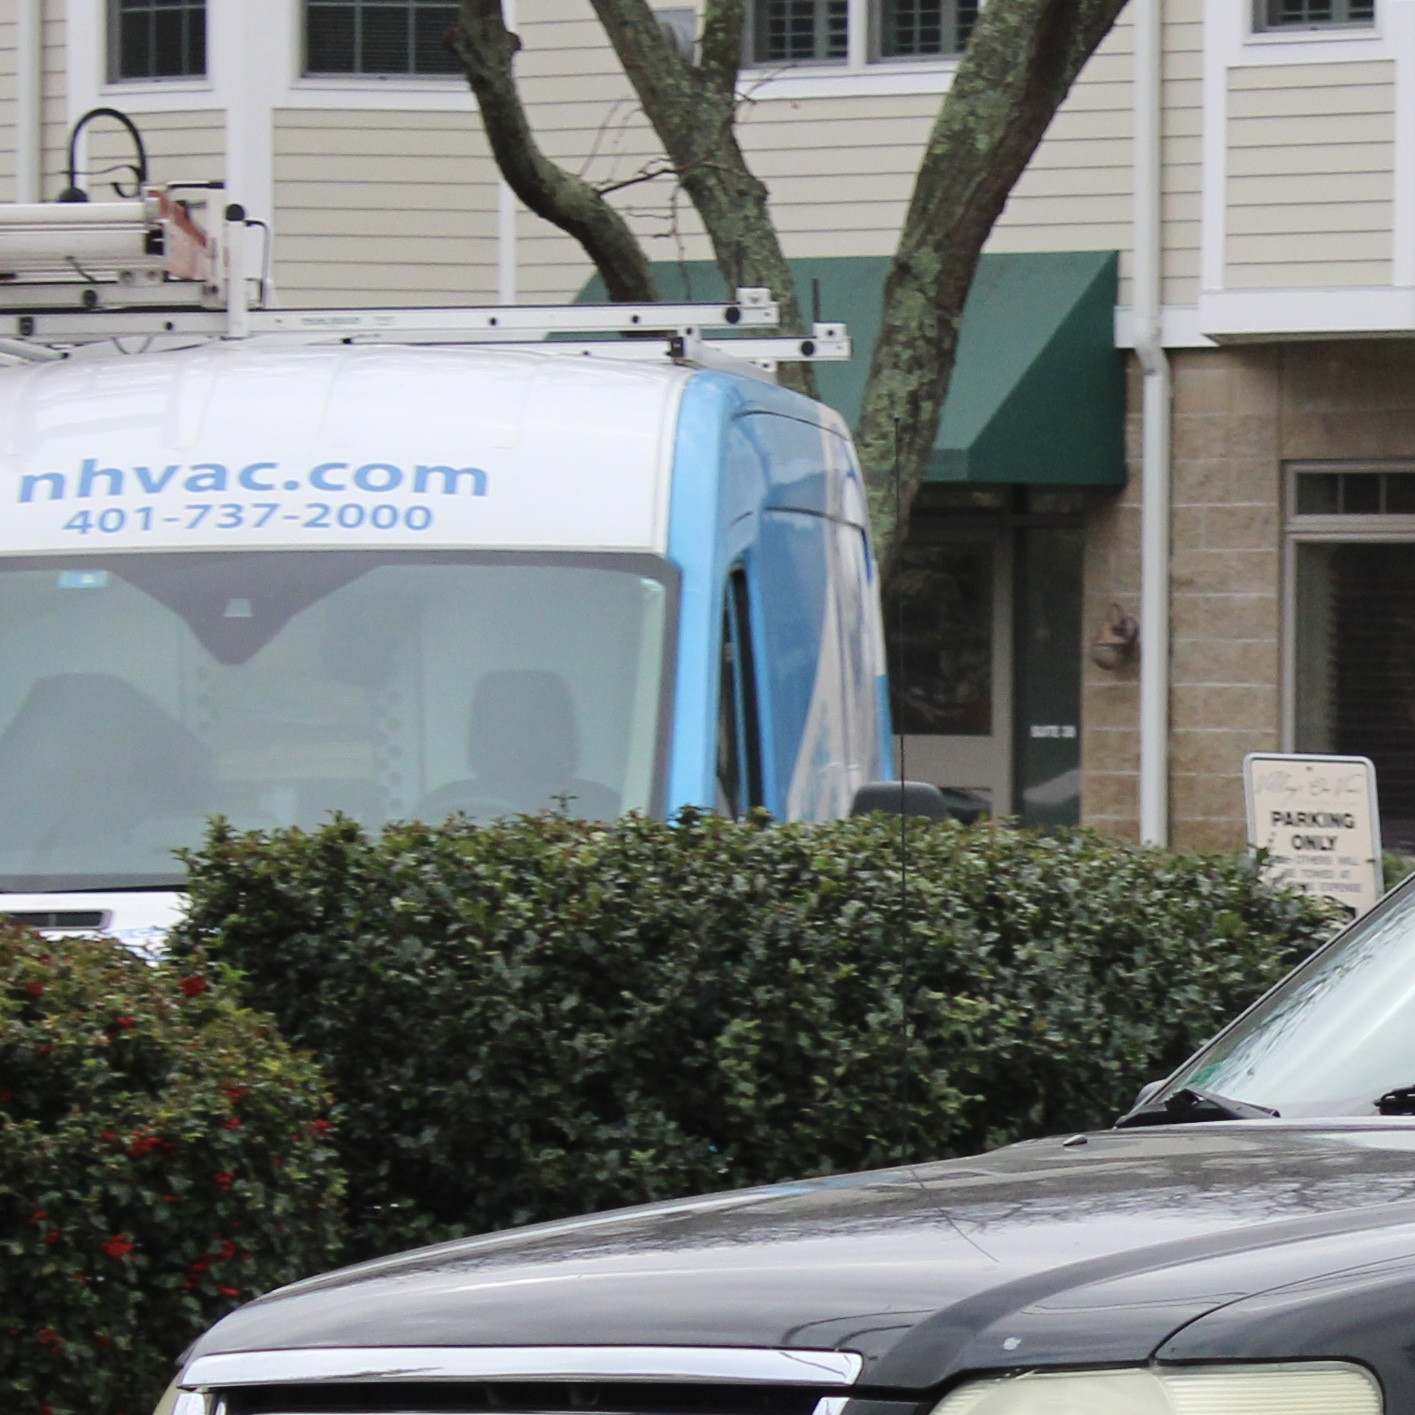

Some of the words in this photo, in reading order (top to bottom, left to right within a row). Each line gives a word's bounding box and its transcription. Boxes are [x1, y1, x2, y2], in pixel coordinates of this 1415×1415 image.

[17, 458, 489, 503] nhvac.com
[62, 503, 433, 535] 401-737-2000
[1270, 810, 1356, 829] PARKING
[1291, 834, 1339, 851] ONLY
